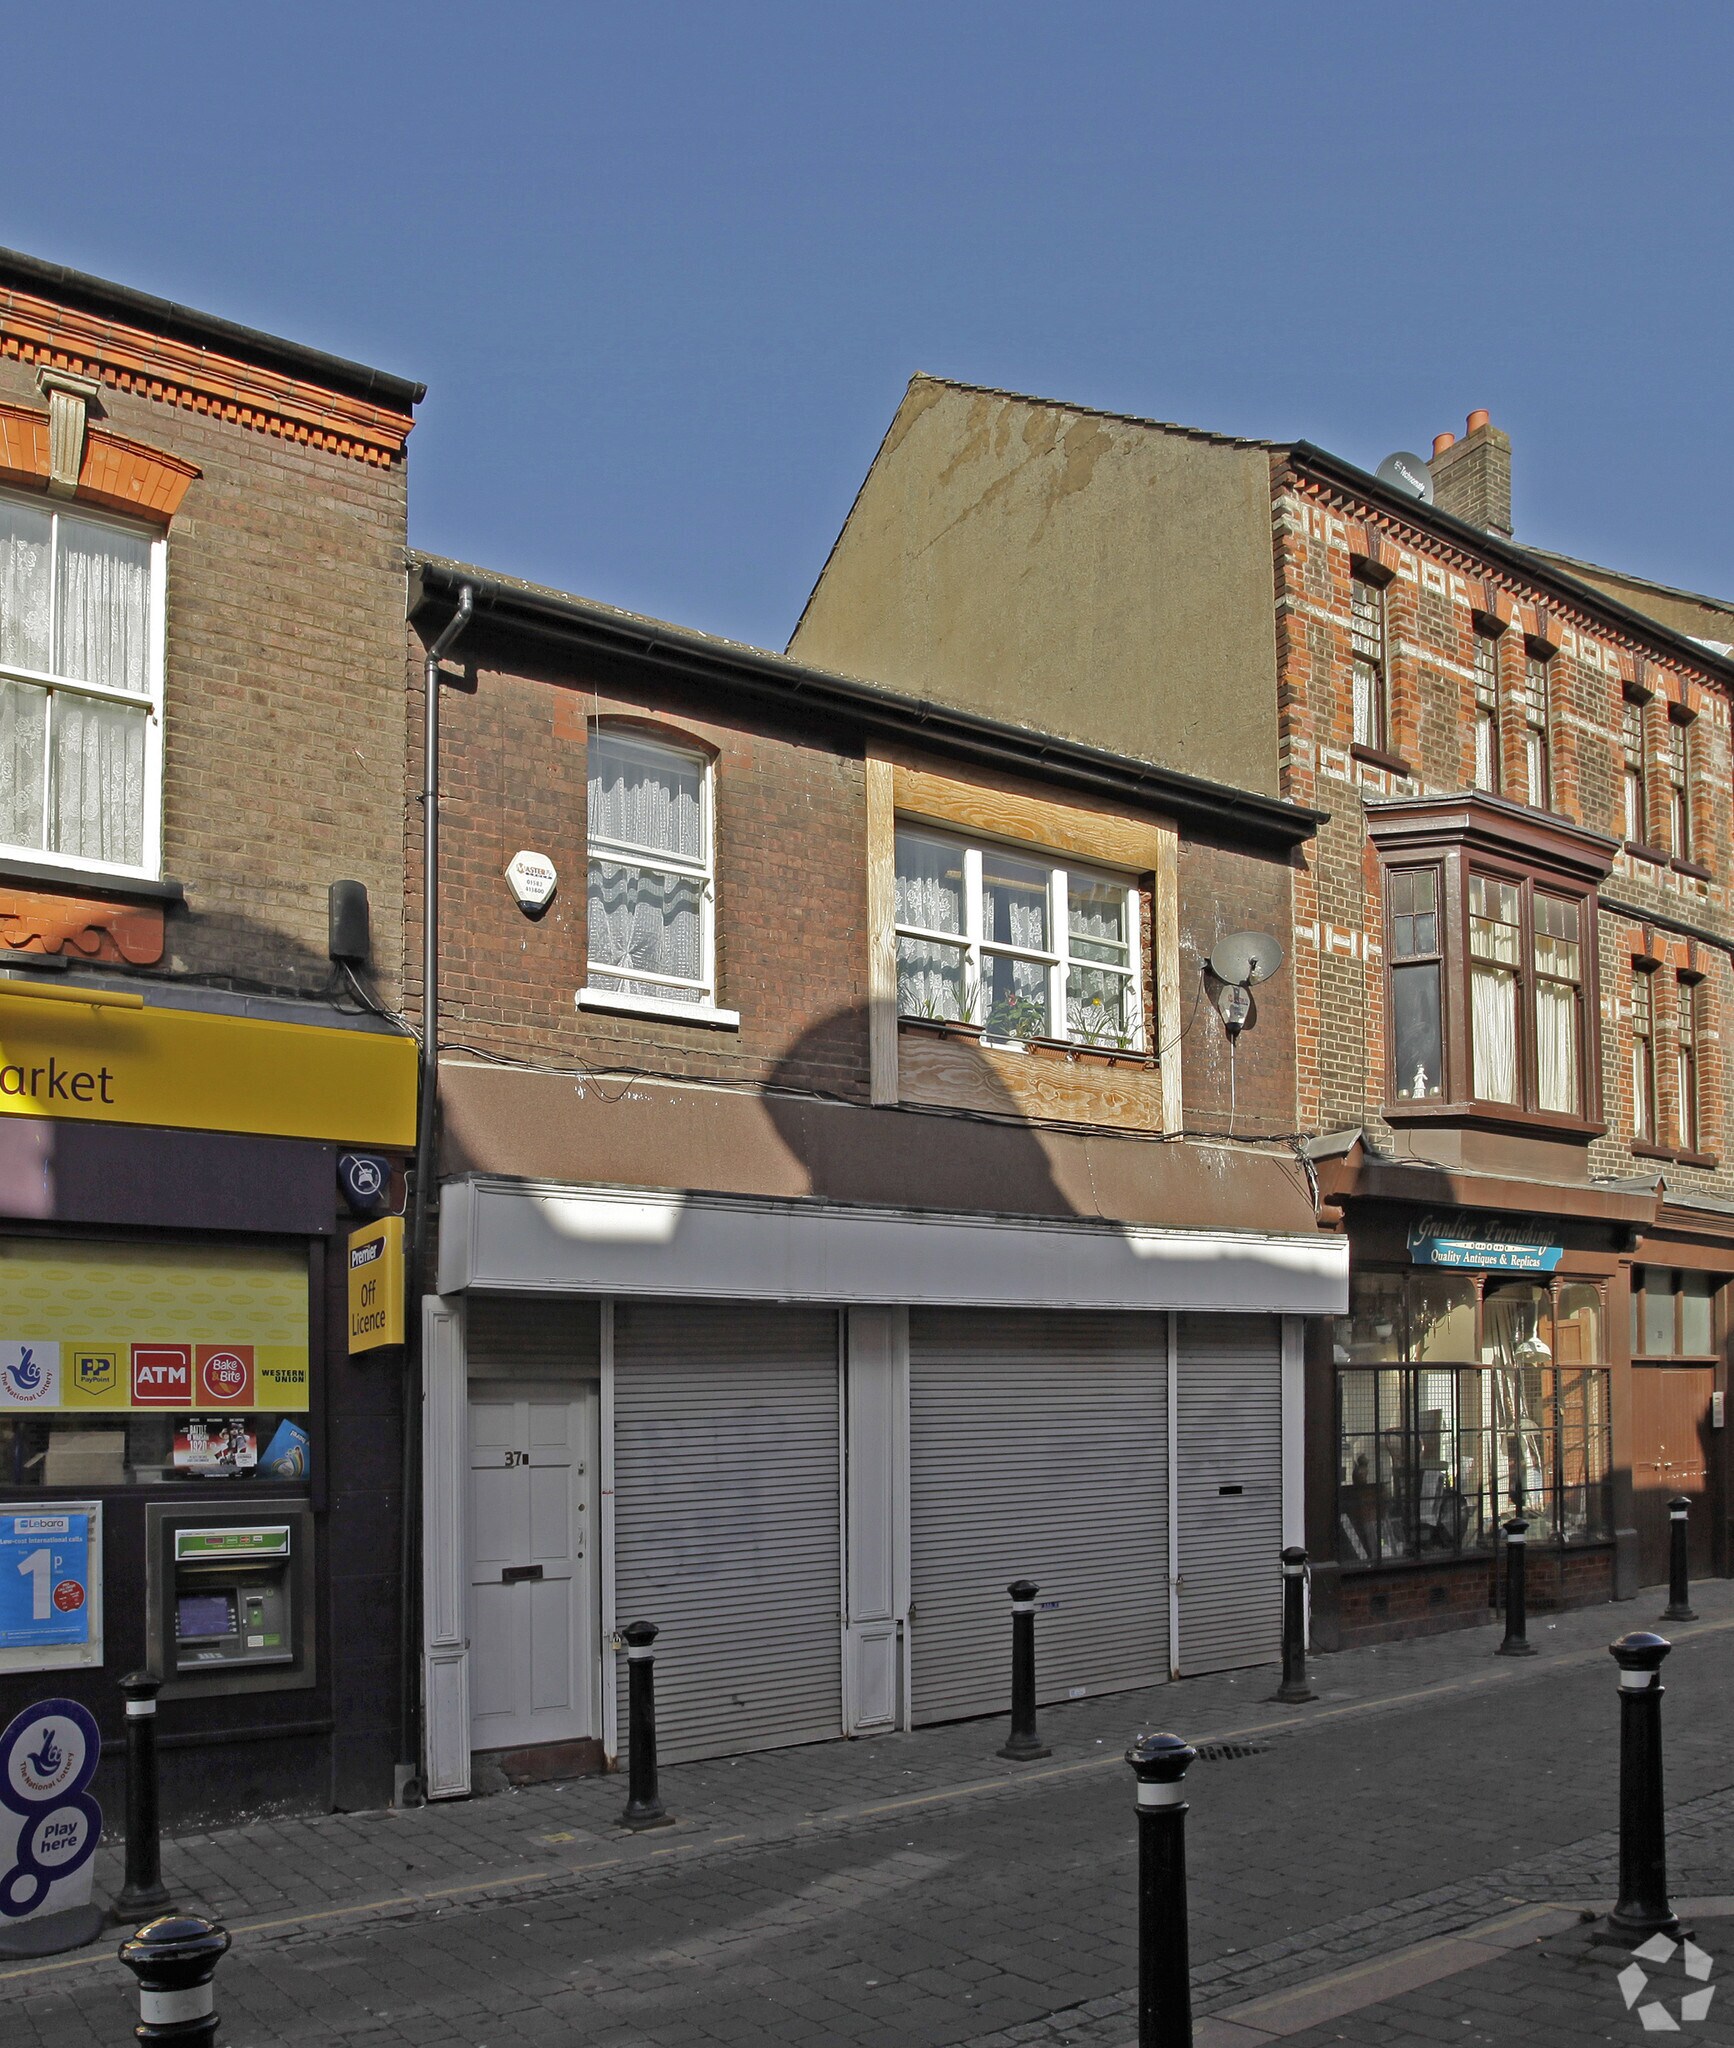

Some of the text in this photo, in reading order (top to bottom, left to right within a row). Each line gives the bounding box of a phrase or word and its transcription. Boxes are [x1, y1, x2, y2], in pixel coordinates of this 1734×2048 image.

[0, 1057, 114, 1104] arket
[1413, 1211, 1558, 1256] Grandior Furnishings
[351, 1244, 377, 1268] Premier
[1430, 1249, 1541, 1268] Quality Antiques & Replicas
[361, 1279, 376, 1308] Off
[352, 1310, 386, 1336] Licence
[213, 1359, 237, 1371] Bake
[137, 1366, 186, 1384] ATM
[220, 1371, 241, 1383] Bite
[0, 1371, 53, 1401] The National Lottery
[190, 1441, 207, 1453] 1920
[29, 1520, 64, 1528] Lebara
[20, 1752, 74, 1790] The National Lottery
[44, 1822, 77, 1838] Play
[41, 1836, 77, 1853] here
